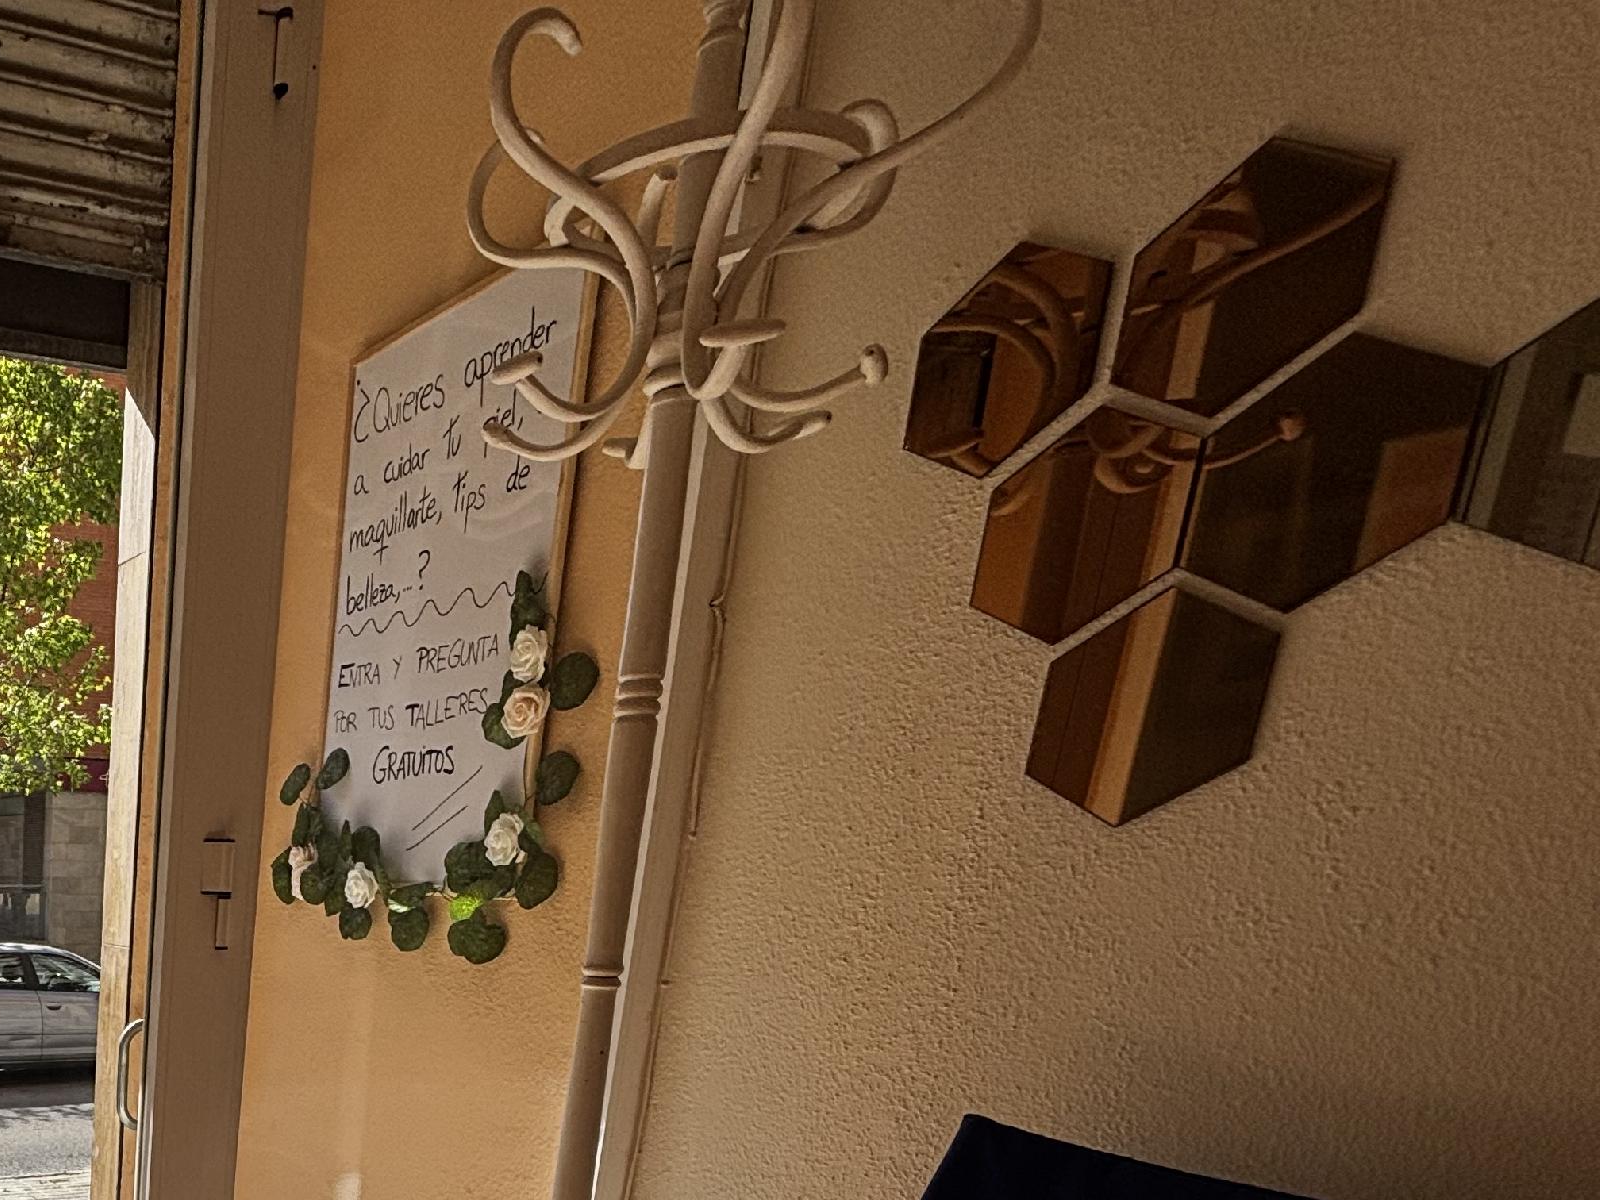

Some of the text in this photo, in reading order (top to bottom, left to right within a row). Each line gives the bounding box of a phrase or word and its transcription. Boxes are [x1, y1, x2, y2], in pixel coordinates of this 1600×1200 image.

[353, 305, 558, 443] ¿Quieres aprender
[353, 474, 370, 496] a
[384, 443, 430, 484] cuidar
[349, 455, 531, 566] maquillarte, tips de
[338, 633, 499, 689] ENTRA Y PREGUNTA
[333, 687, 489, 733] POR TUS TALLERES
